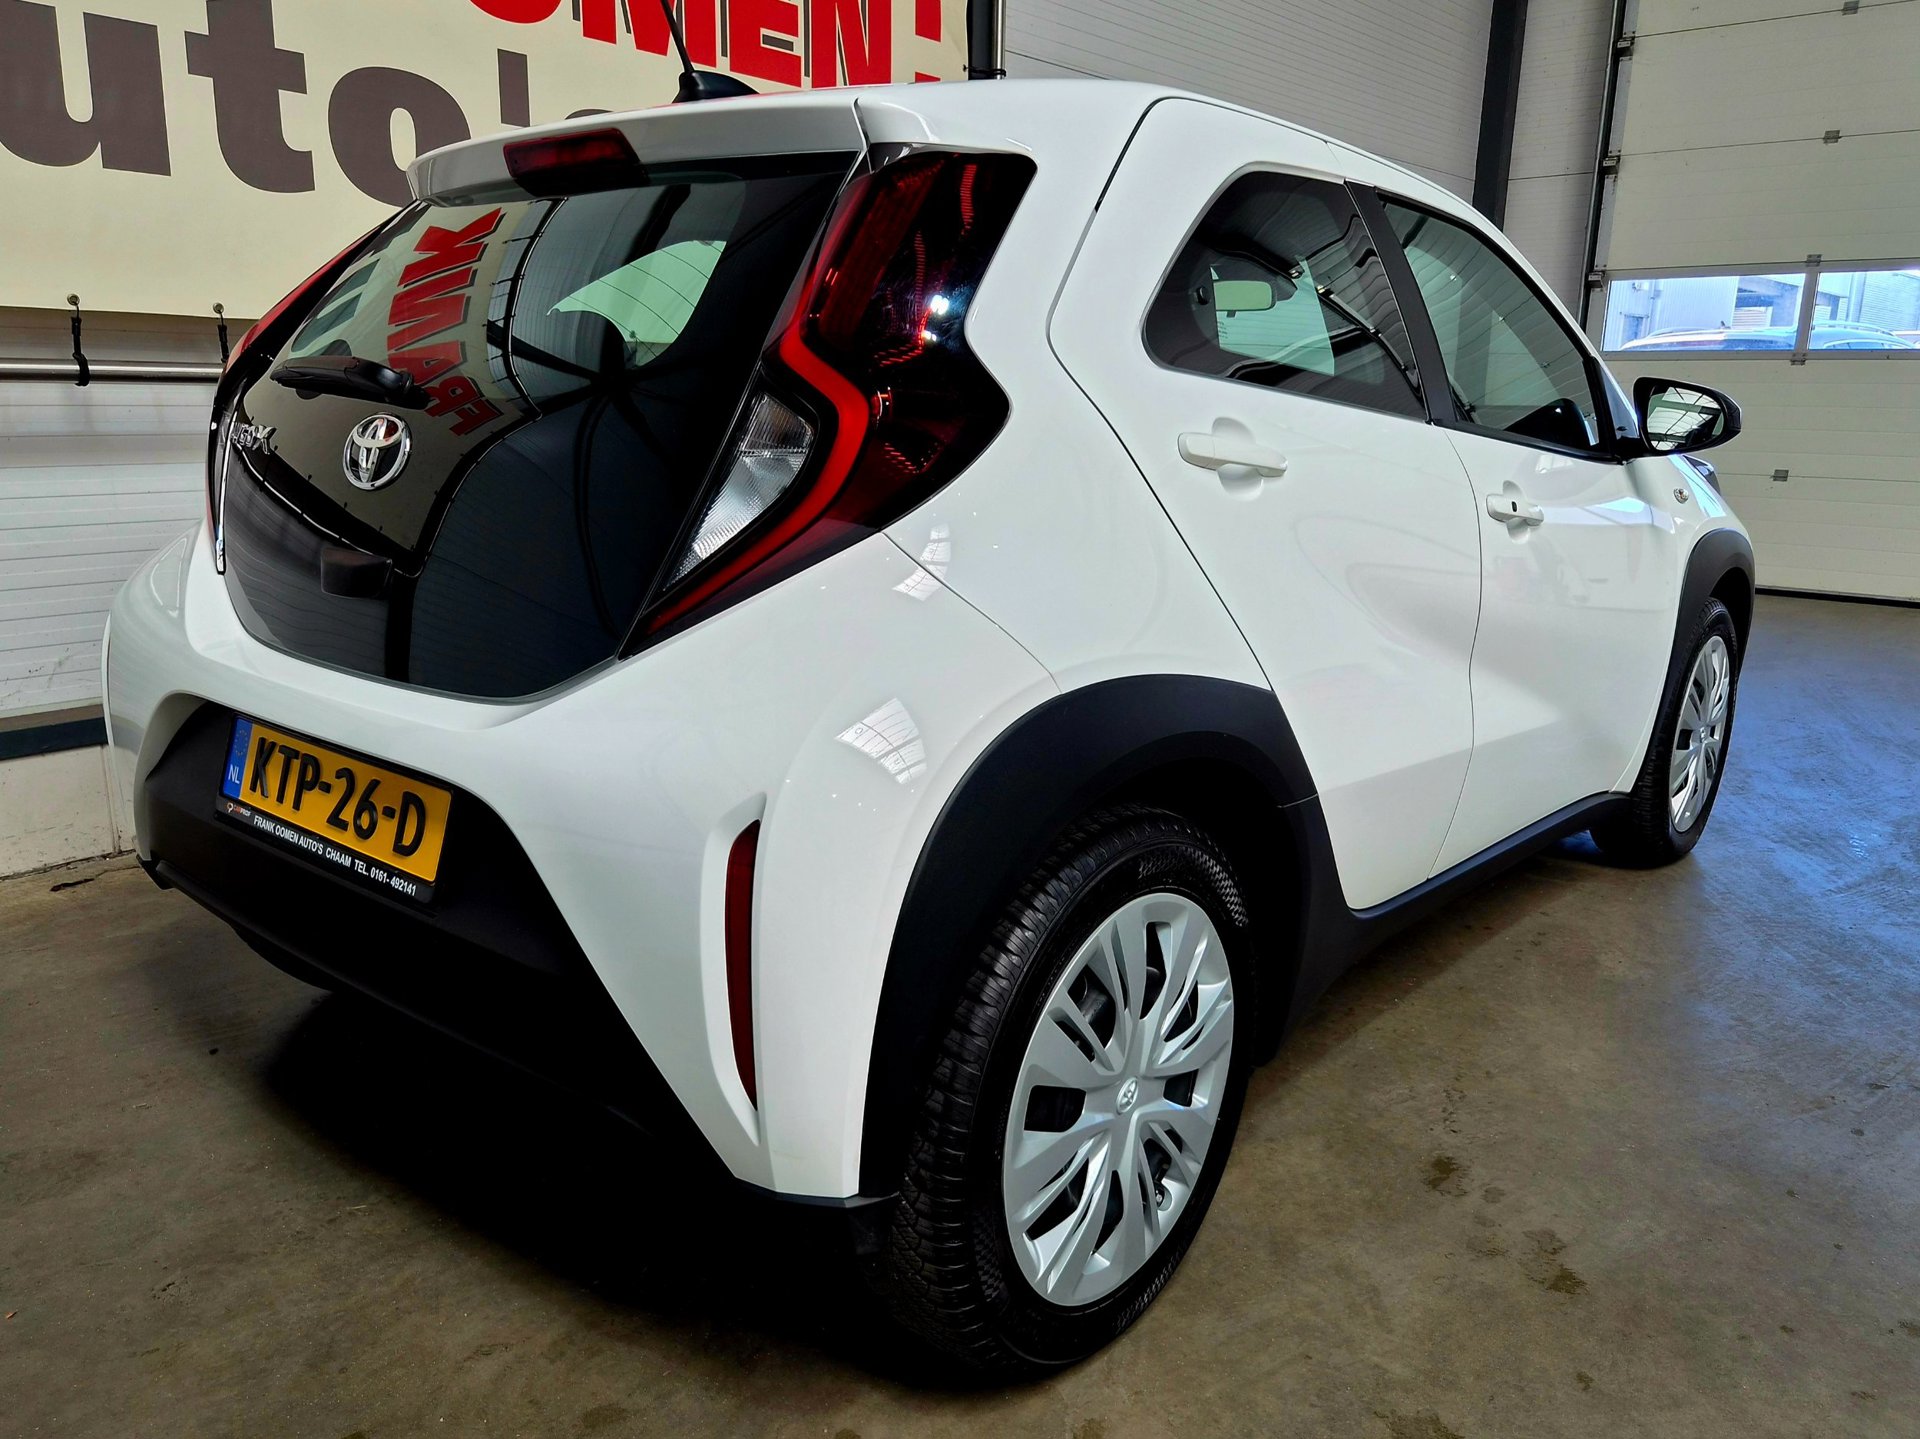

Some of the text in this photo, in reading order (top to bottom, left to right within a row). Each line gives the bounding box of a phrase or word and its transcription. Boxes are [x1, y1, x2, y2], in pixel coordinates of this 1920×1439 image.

[0, 0, 615, 208] uto'
[228, 764, 240, 784] NL
[250, 736, 426, 857] KTP-26-D
[253, 815, 275, 833] FRANK
[275, 825, 299, 844] OOMEN
[298, 835, 324, 855] AUTO'S
[325, 847, 351, 867] CHAAM
[354, 859, 369, 876] TEL.
